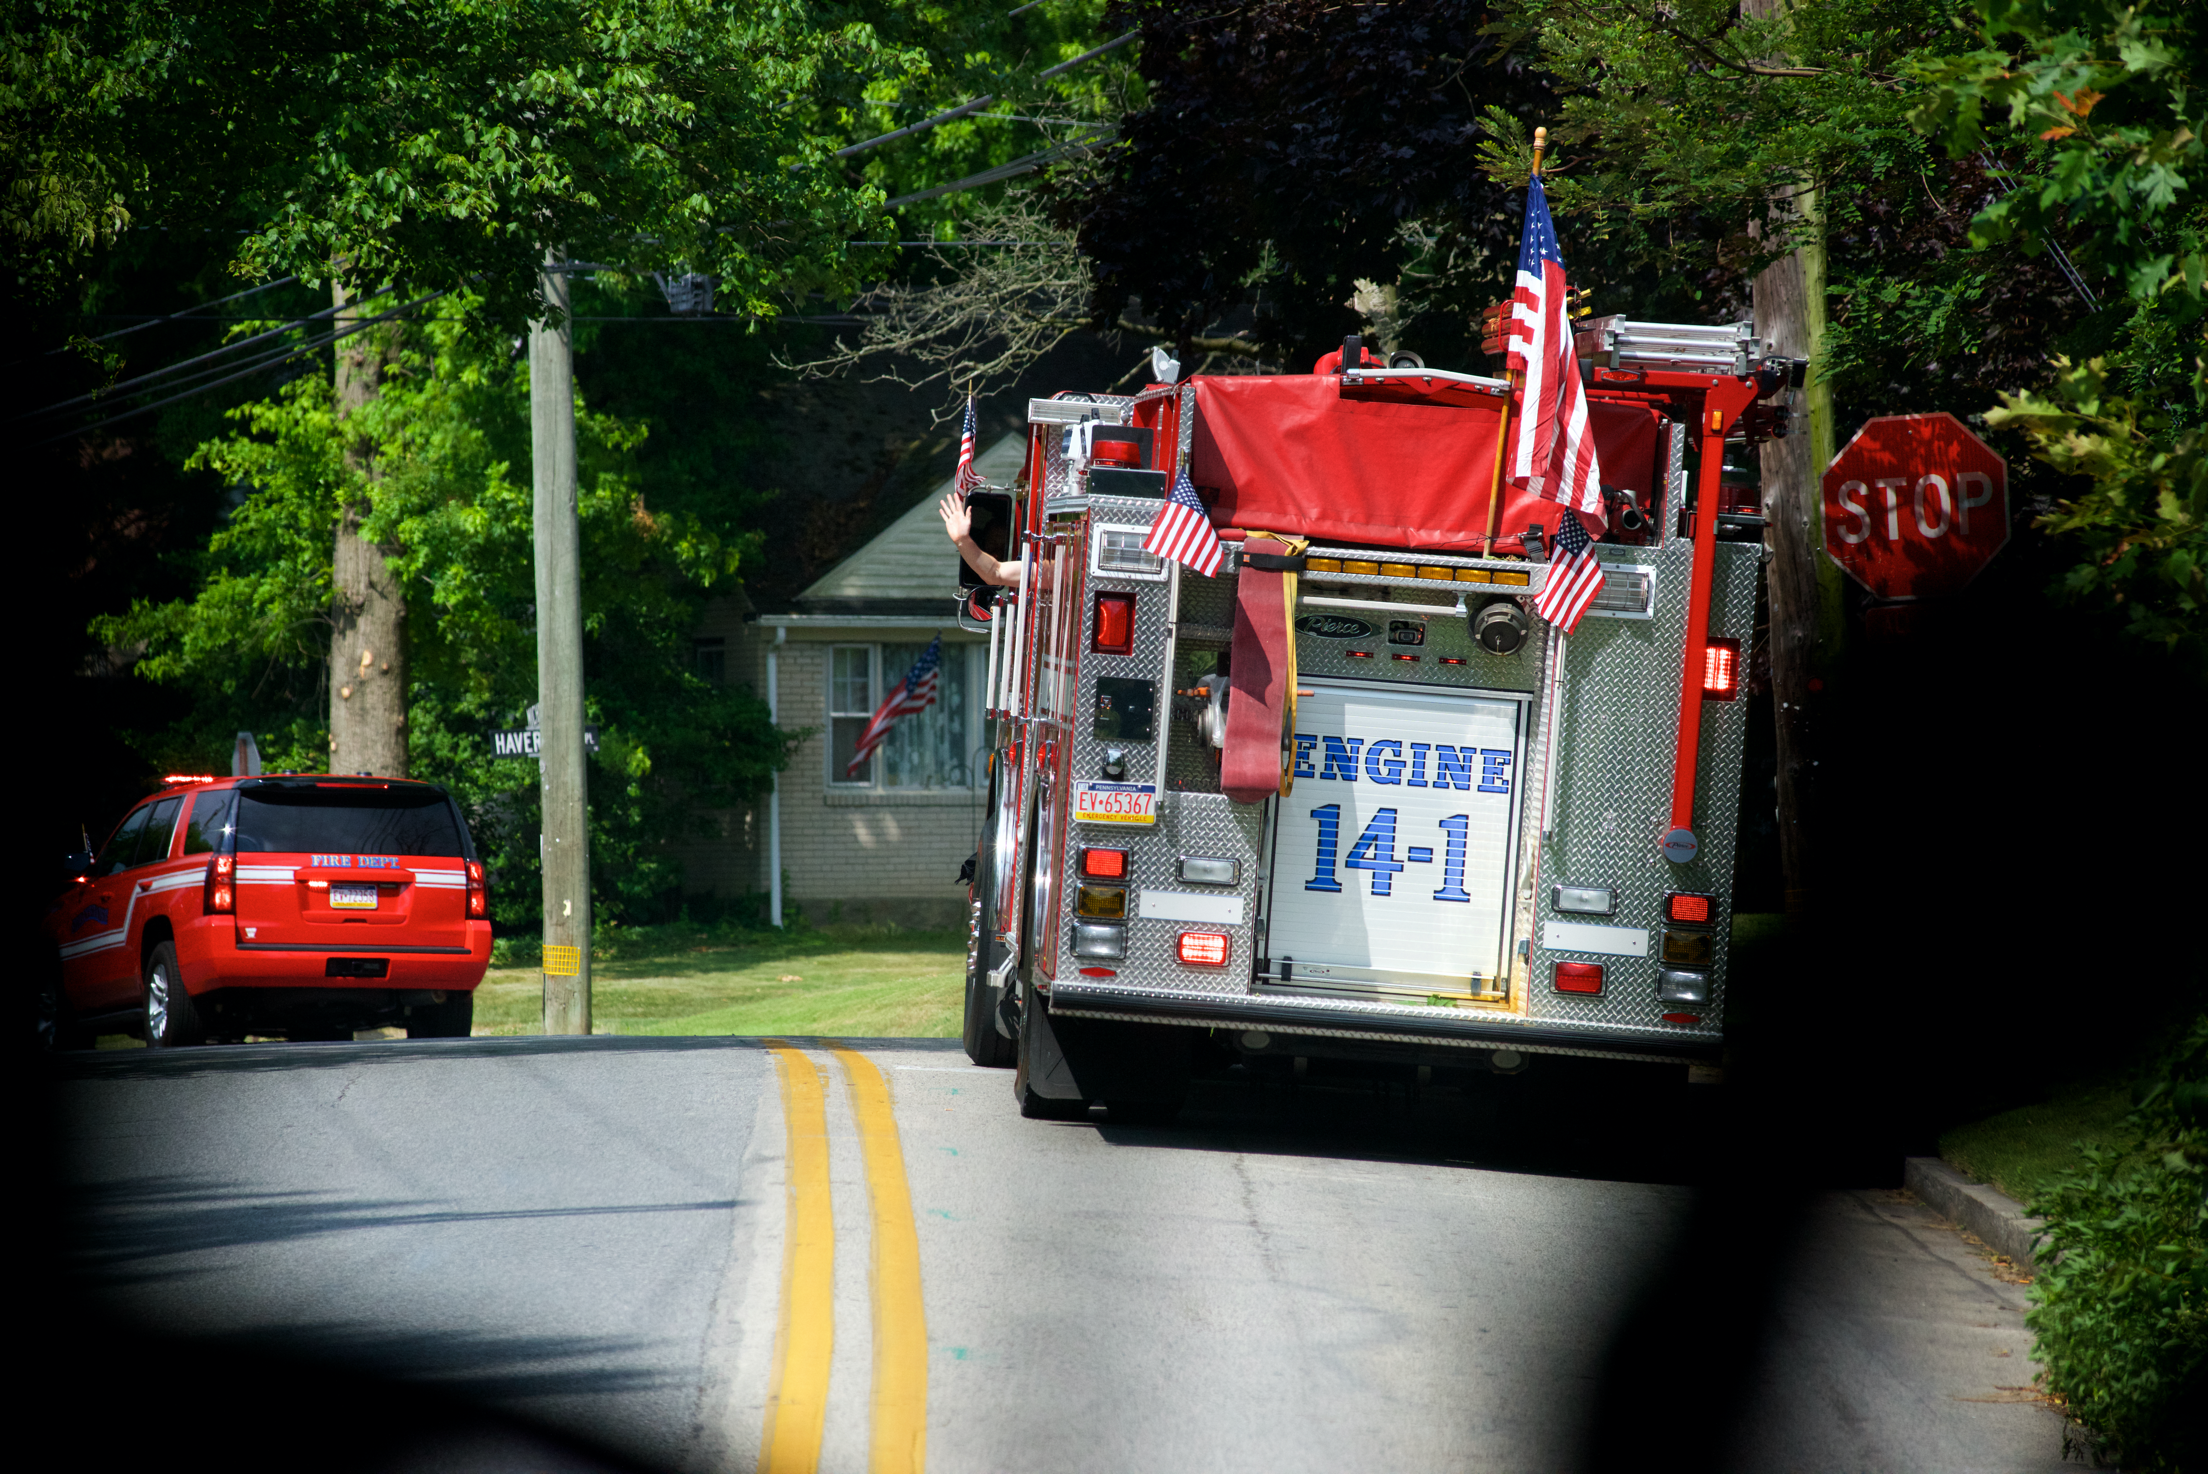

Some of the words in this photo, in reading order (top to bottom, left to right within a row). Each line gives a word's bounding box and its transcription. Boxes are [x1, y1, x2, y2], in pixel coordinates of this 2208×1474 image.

[1837, 471, 1994, 544] STOP
[1303, 616, 1360, 634] Pierce
[494, 731, 541, 755] HAVER
[1287, 733, 1512, 794] ENGINE
[1095, 784, 1137, 792] PENNSYLVANIA
[311, 854, 351, 868] FIRE
[357, 855, 400, 869] DEPT
[1304, 803, 1471, 903] 14-1
